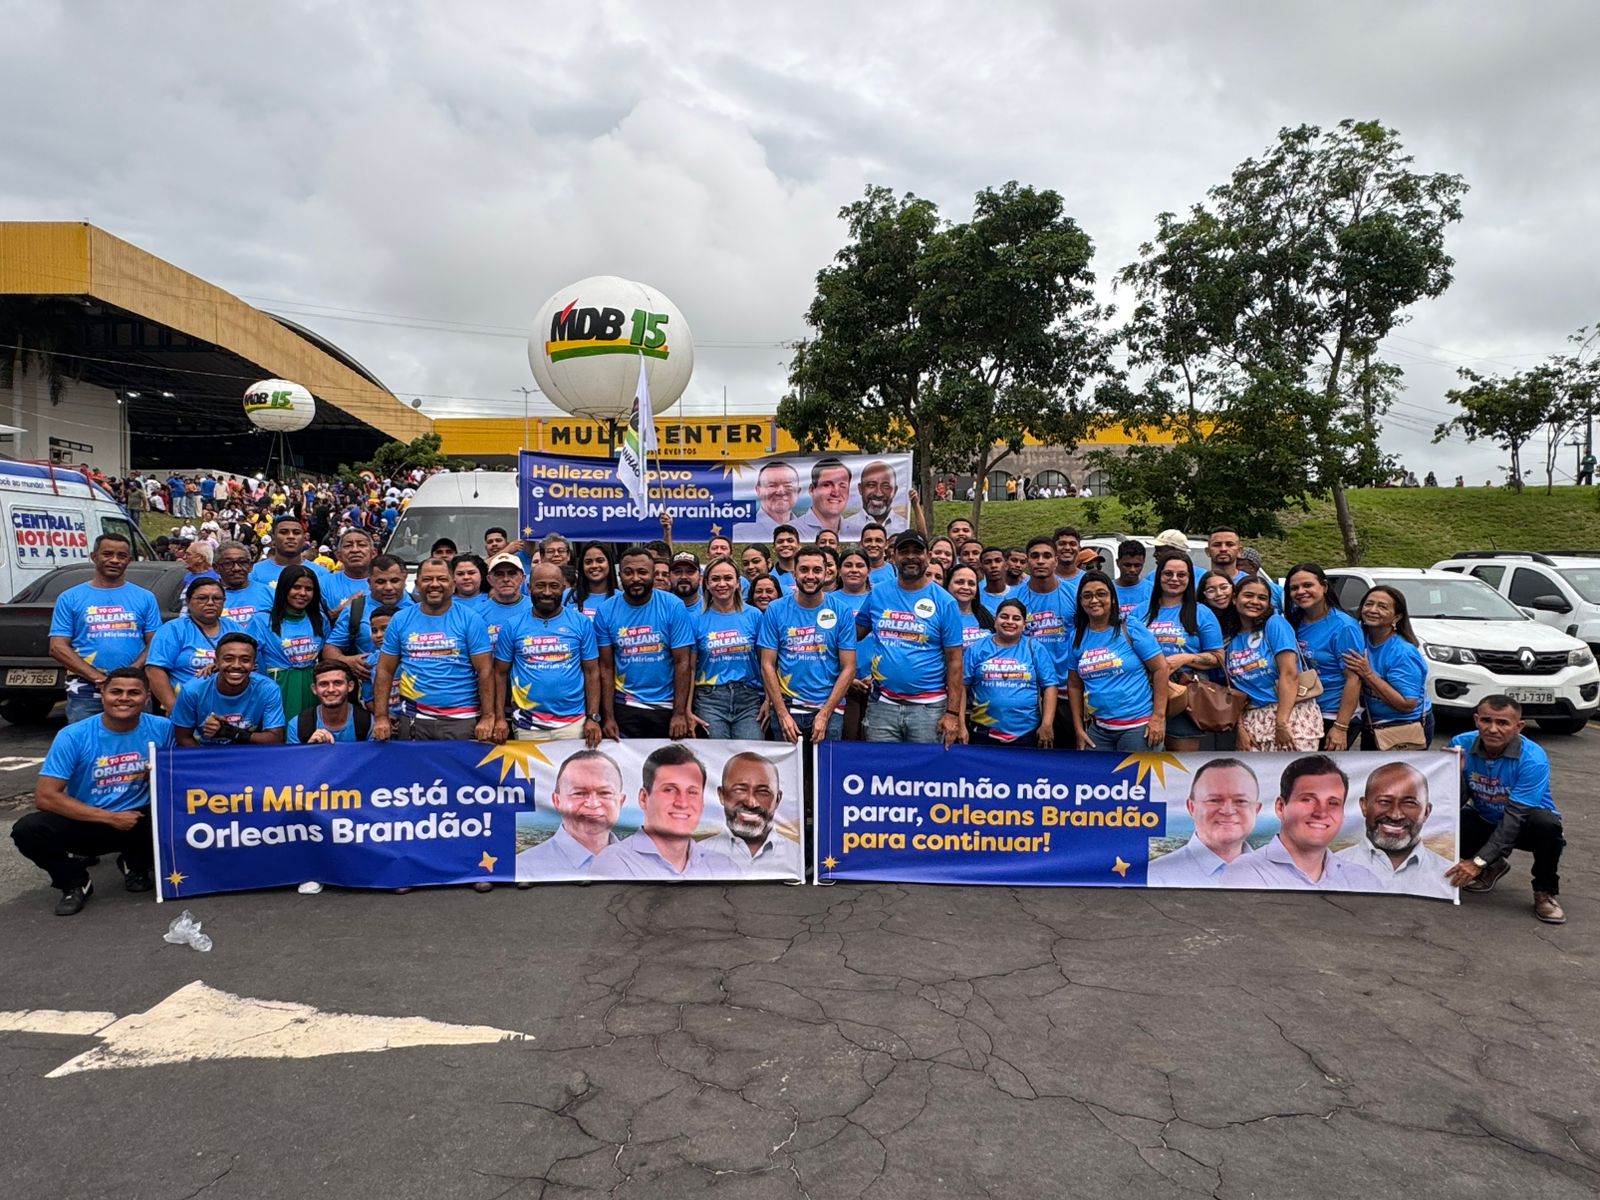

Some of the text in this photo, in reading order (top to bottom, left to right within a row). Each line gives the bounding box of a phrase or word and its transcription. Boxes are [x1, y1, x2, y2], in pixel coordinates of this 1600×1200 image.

[551, 299, 669, 348] MDB 15
[272, 391, 292, 407] 15
[532, 464, 612, 480] Heliezer
[645, 470, 693, 484] povo
[532, 486, 545, 498] e
[549, 483, 624, 499] Orleans
[534, 502, 599, 522] juntos
[646, 502, 752, 519] Maranhão!
[12, 513, 86, 531] CENTRAL DE
[19, 547, 88, 558] BRASIL
[86, 613, 135, 624] ORLEANS
[878, 619, 925, 633] ORLEANS
[617, 634, 661, 647] ORLEANS
[707, 636, 749, 648] ORLEANS
[522, 643, 569, 655] ORLEANS
[981, 663, 1027, 672] ORLEANS
[120, 754, 138, 762] COM
[186, 779, 526, 815] Peri Mirim está com
[842, 774, 1147, 806] O Maranhão não pode
[843, 803, 1160, 828] parar, Orleans Brandão
[185, 812, 492, 849] Orleans Brandão!
[843, 830, 1051, 854] para continuar!
